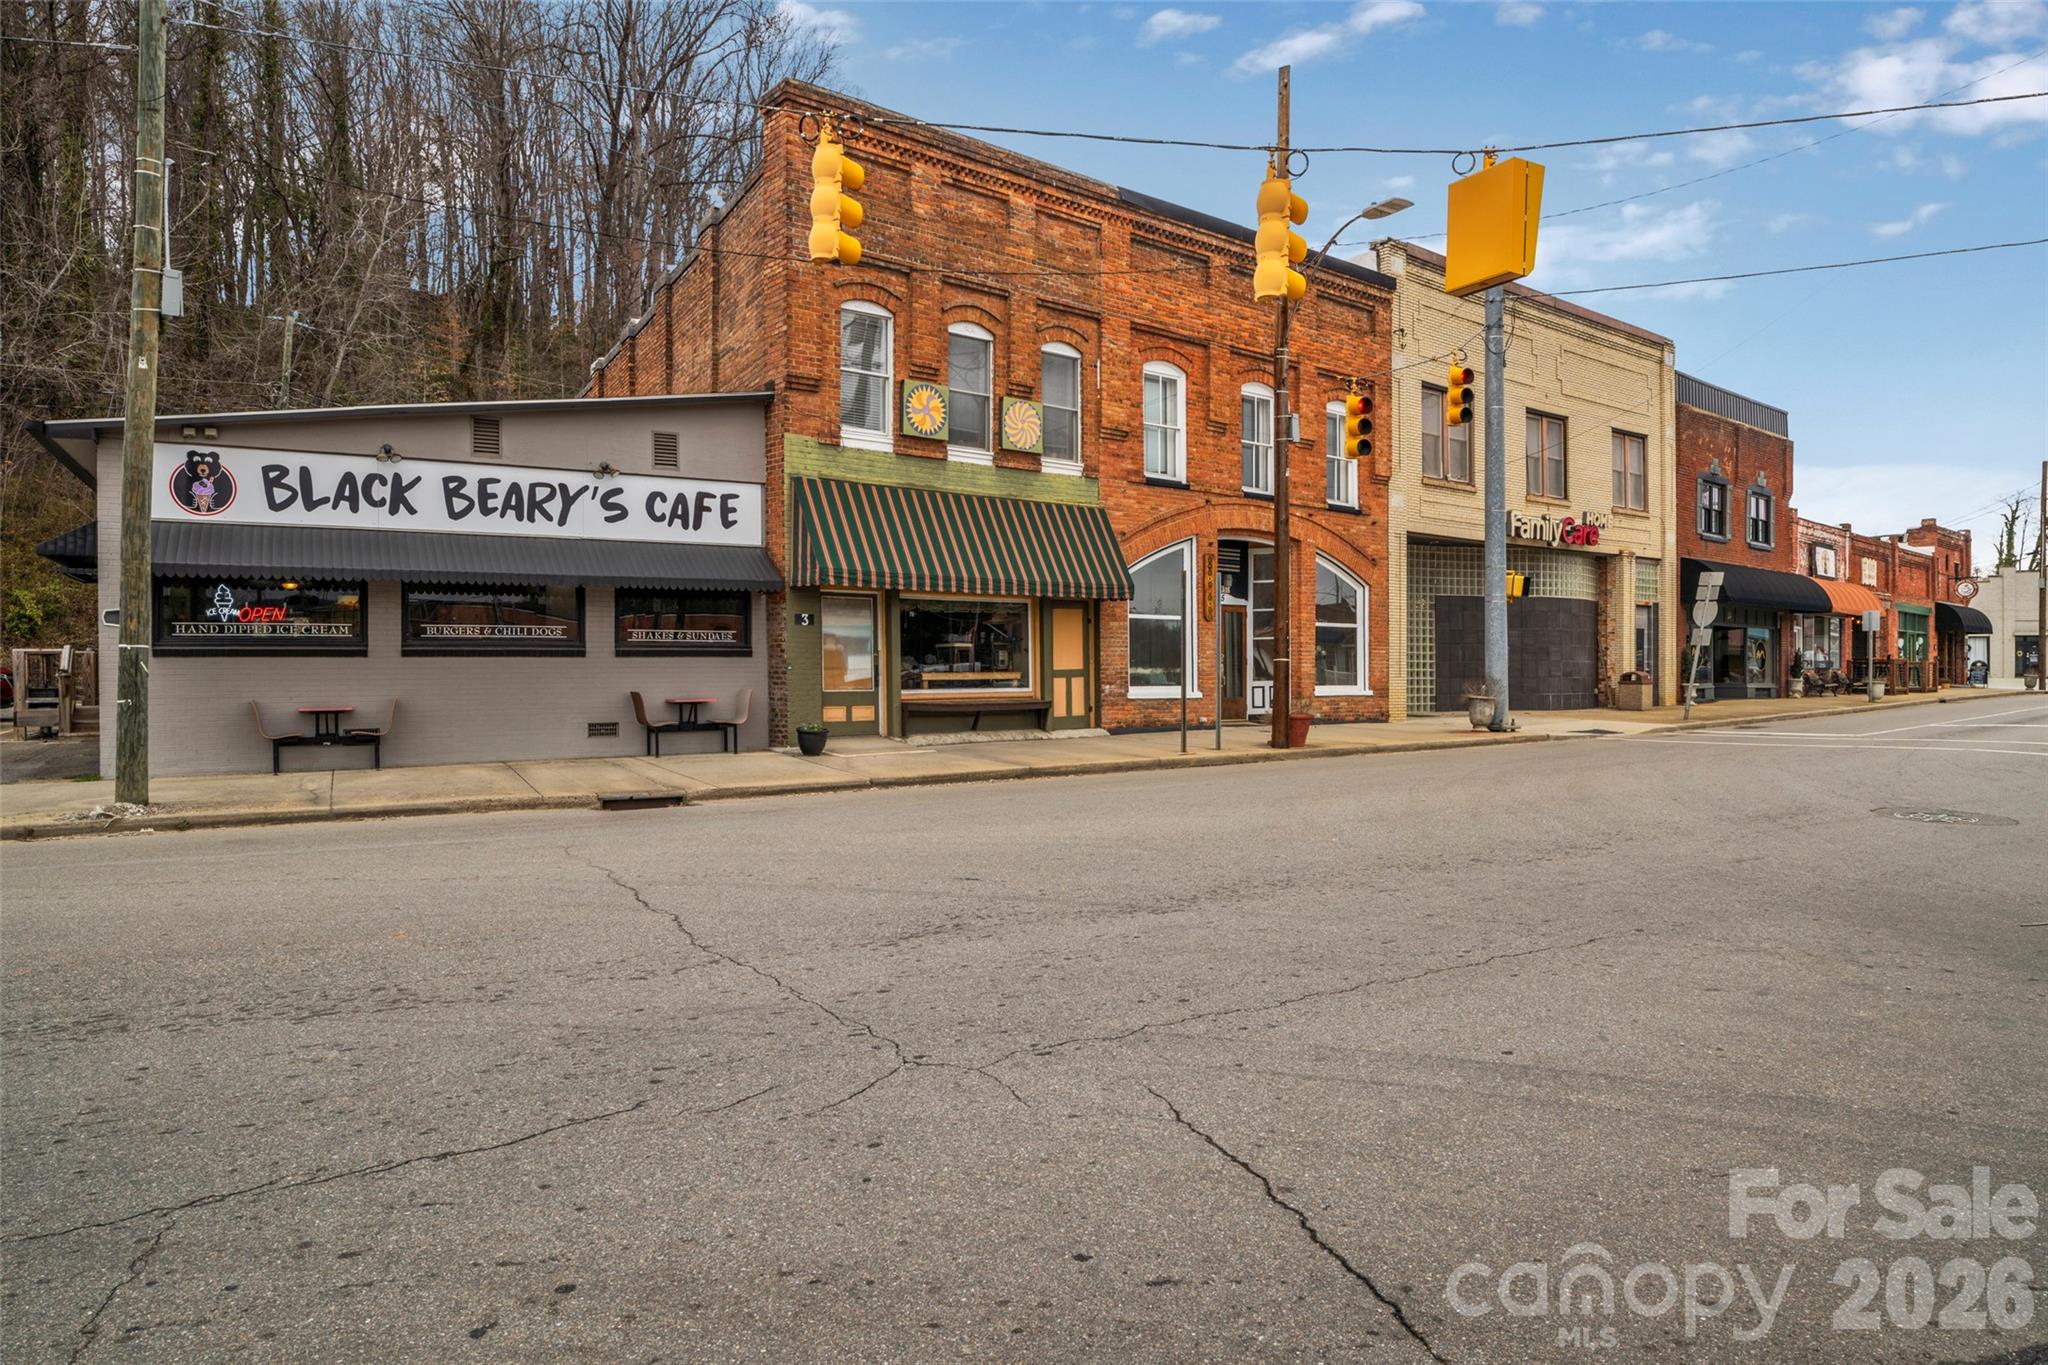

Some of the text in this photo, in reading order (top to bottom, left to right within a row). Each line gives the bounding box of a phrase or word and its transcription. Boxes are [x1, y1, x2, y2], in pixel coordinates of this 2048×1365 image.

[262, 464, 739, 531] BLACK BEARY'S CAFE
[206, 608, 217, 617] ICE
[239, 607, 285, 623] OPEN
[801, 613, 808, 626] 3
[176, 624, 350, 635] HAND DIPPED ICE CREAM
[426, 626, 563, 636] BURGERS & CHILI DOGS
[632, 631, 674, 640] SHAKES
[686, 632, 733, 641] SUNDAES
